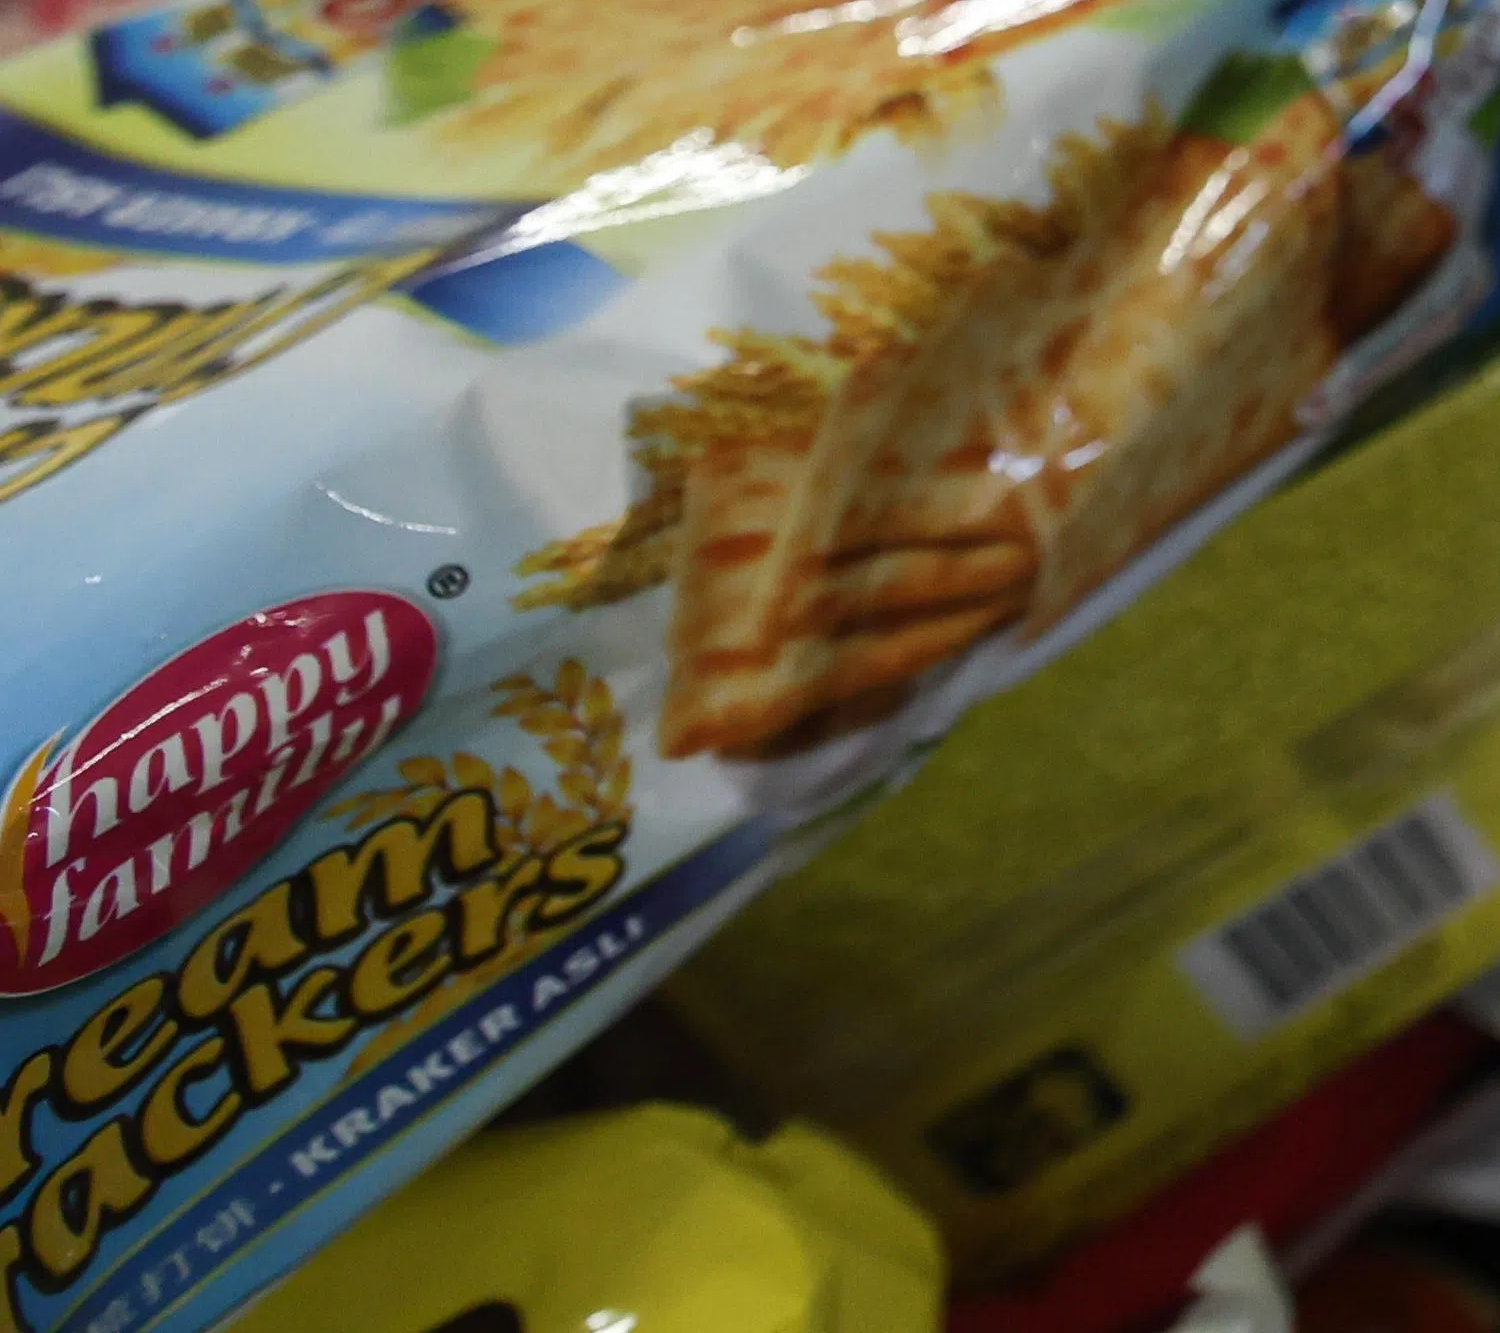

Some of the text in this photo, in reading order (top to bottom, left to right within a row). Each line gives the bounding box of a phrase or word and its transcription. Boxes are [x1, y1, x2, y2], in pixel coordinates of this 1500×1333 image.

[36, 695, 402, 966] family
[43, 609, 393, 869] happy
[291, 916, 646, 1179] KRAKER ASLI
